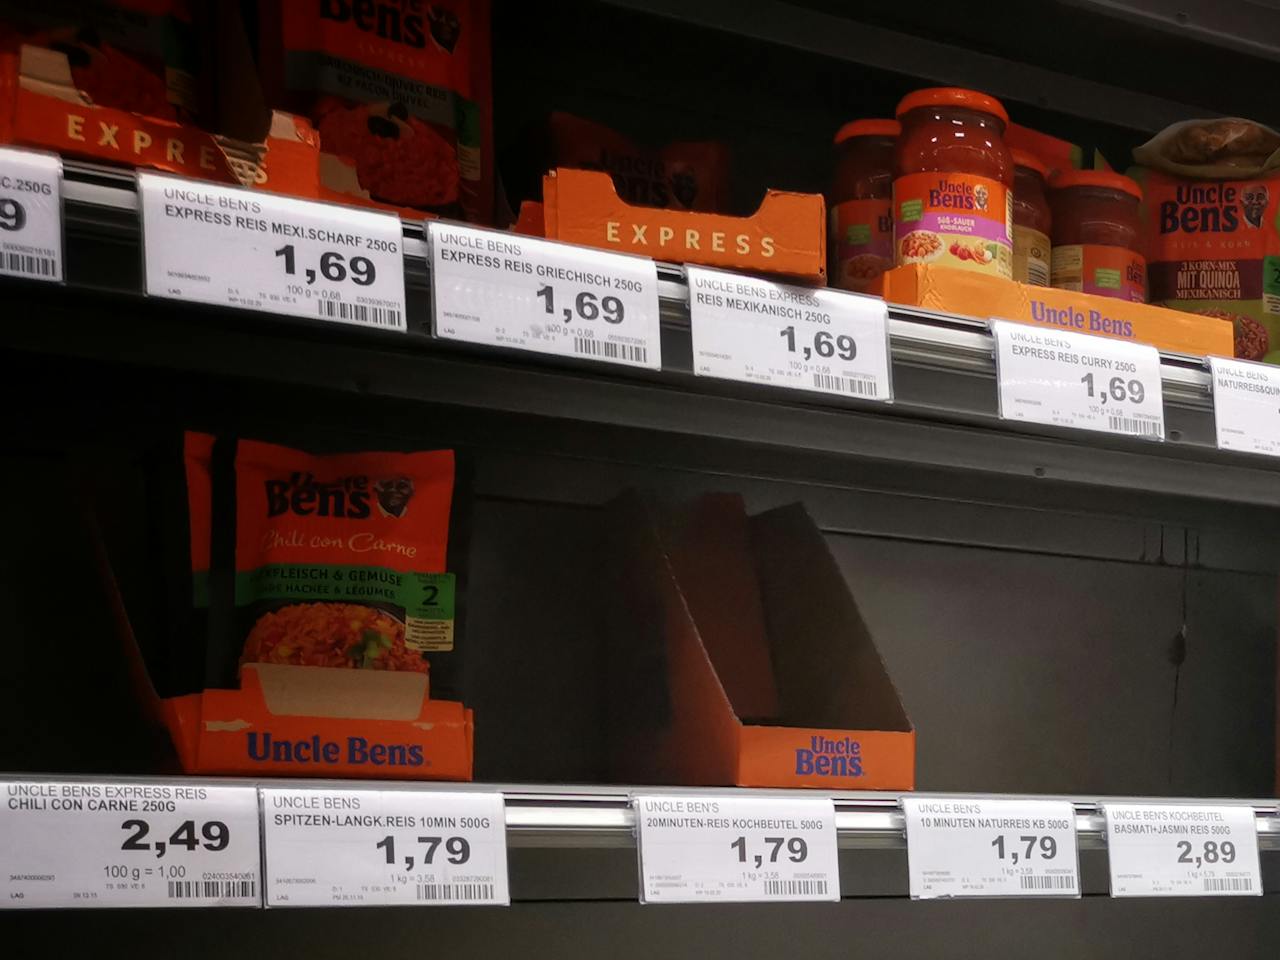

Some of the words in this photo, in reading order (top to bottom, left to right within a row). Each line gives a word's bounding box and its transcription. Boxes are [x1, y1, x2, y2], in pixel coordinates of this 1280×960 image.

[164, 204, 232, 226] EXPRESS
[236, 214, 268, 232] REIS
[272, 223, 362, 248] MEXI.SCHARF
[366, 237, 398, 254] 250G
[606, 222, 776, 257] EXPRESS
[275, 244, 376, 286] 1,69
[440, 248, 501, 270] EXPRESS
[504, 259, 533, 275] REIS
[536, 264, 611, 288] GRIECHISCH
[614, 278, 642, 293] 250G
[1178, 270, 1197, 288] MIT
[1199, 272, 1240, 290] QUINOA
[536, 286, 626, 324] 1,69
[696, 292, 722, 306] REIS
[726, 297, 798, 320] MEXIKANISCH
[801, 309, 831, 324] 250G
[1030, 300, 1085, 328] Uncle
[780, 326, 857, 360] 1,69
[1080, 372, 1145, 404] 1,69
[247, 732, 340, 764] Uncle
[810, 736, 860, 755] Uncle
[7, 784, 56, 798] UNCLE
[62, 785, 101, 800] BENS
[104, 786, 172, 800] EXPRESS
[174, 787, 207, 800] REIS
[8, 798, 50, 811] CHILI
[54, 798, 84, 812] CON
[86, 799, 138, 812] CARNE
[142, 800, 176, 812] 250G
[274, 814, 416, 829] SPITZEN-LANGK.REIS
[419, 816, 457, 828] 10MIN
[460, 816, 490, 829] 500G
[647, 818, 730, 830] 20MINUTEN-REIS
[732, 818, 798, 830] KOCHBEUTEL
[800, 818, 823, 830] 500G
[920, 818, 930, 828] 10
[932, 818, 974, 829] MINUTEN
[976, 818, 1030, 830] NATURREIS
[1032, 818, 1045, 829] KB
[1047, 818, 1070, 830] 500G
[1114, 824, 1188, 836] BASMATI+JASMIN
[1190, 825, 1208, 836] REIS
[1210, 825, 1231, 836] 500G
[120, 818, 230, 858] 2,49
[375, 836, 472, 871] 1,79
[730, 836, 808, 868] 1,79
[990, 835, 1058, 864] 1,79
[1176, 840, 1236, 867] 2,89
